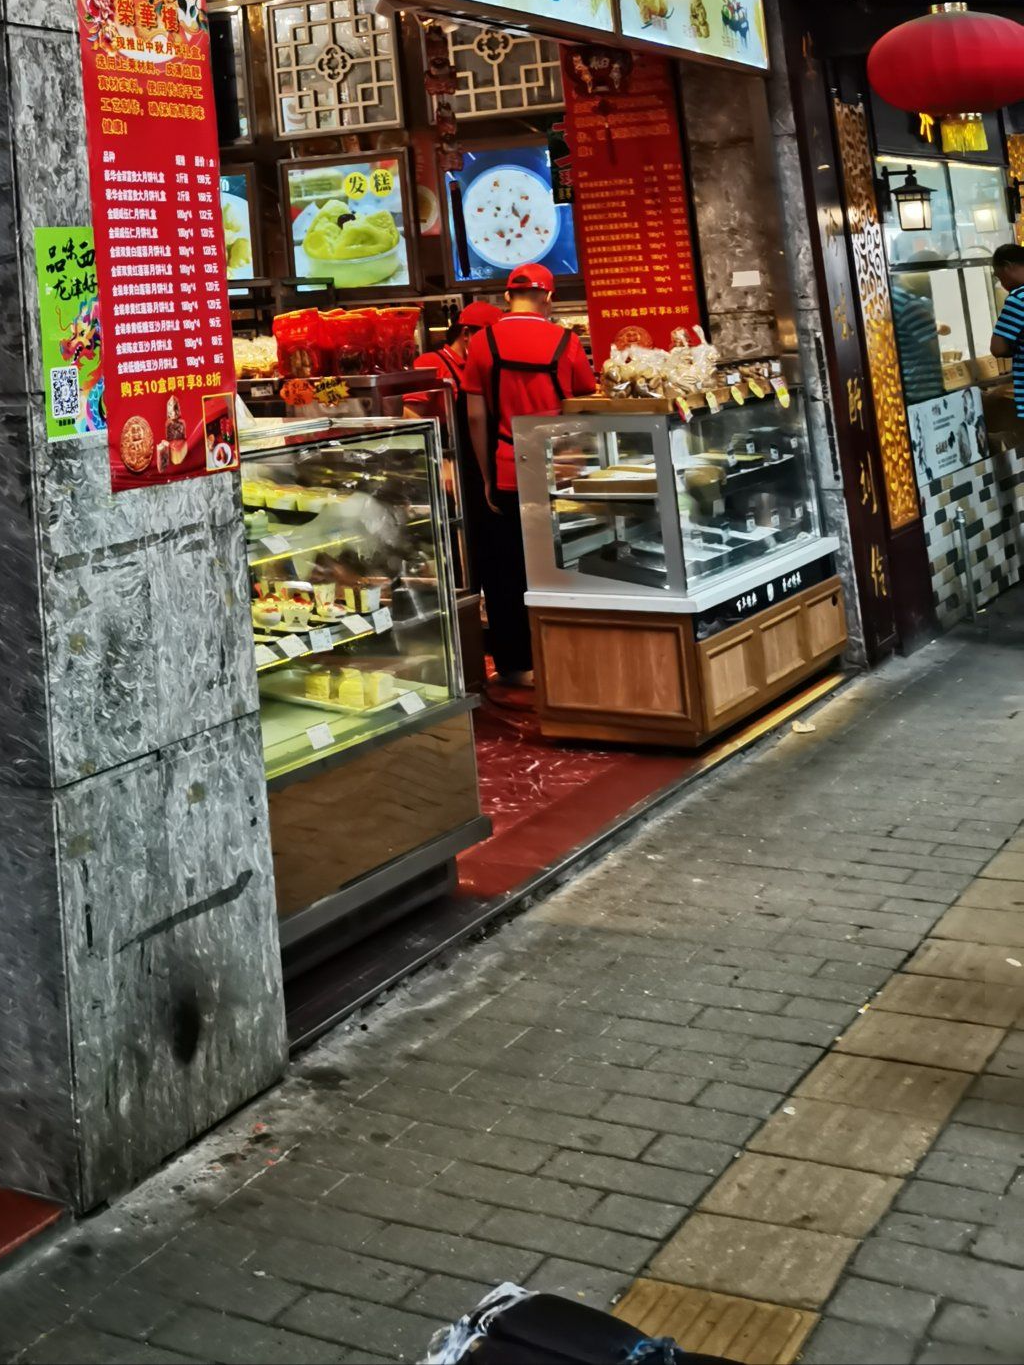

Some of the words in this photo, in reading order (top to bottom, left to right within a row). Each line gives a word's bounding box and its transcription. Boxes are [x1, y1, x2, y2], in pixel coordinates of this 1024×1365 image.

[348, 170, 394, 194] 发糕
[121, 373, 221, 398] 购买10盒即可享8.8折
